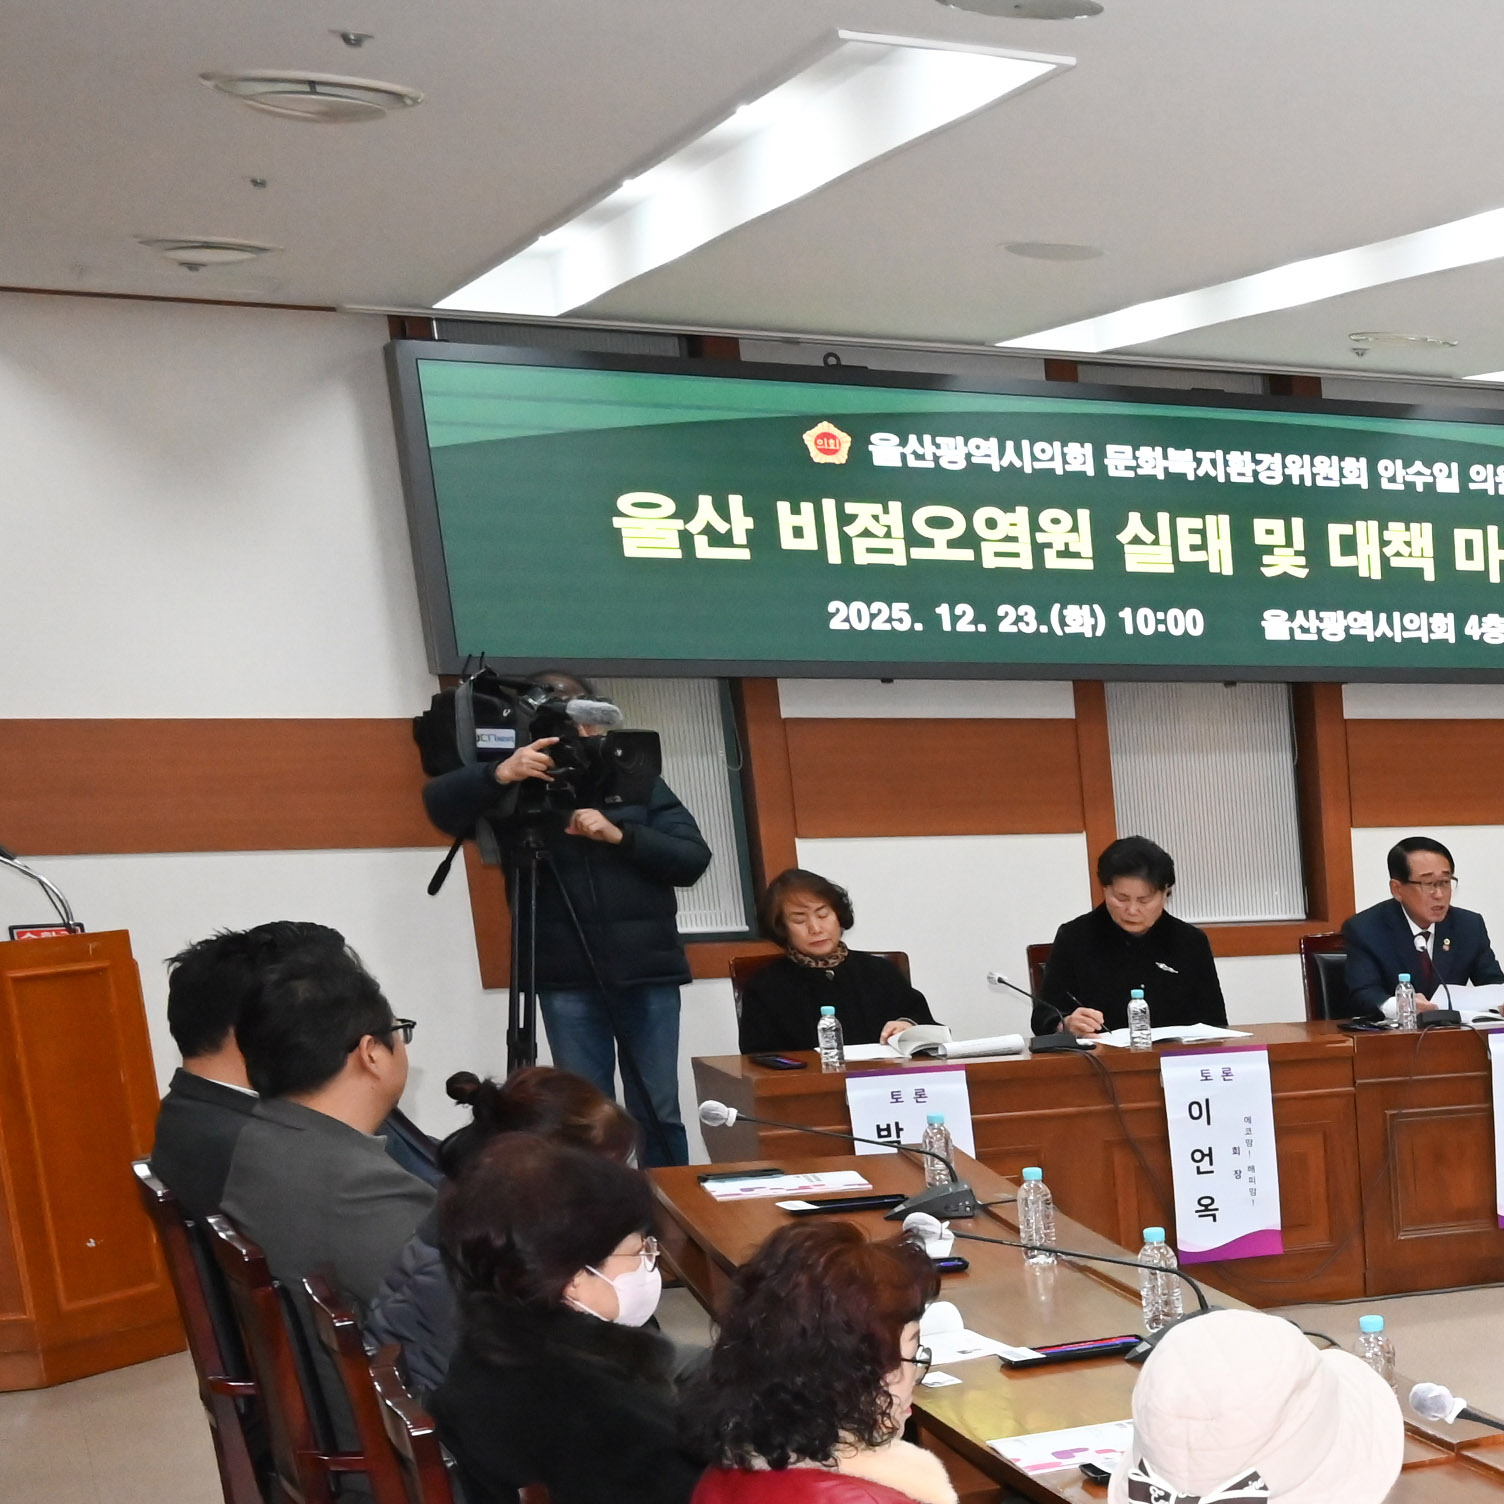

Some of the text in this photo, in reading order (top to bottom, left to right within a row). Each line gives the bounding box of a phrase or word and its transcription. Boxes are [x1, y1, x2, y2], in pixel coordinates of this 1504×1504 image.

[816, 437, 840, 450] 의회
[868, 432, 1095, 477] 울산광역시의회
[1103, 444, 1369, 490] 문화복지환경위원회
[1377, 458, 1460, 494] 안수일
[612, 491, 754, 560] 울산
[776, 498, 1094, 570] 비점오염원
[1115, 511, 1234, 576] 실태
[1253, 517, 1310, 579] 및
[1327, 520, 1436, 582] 대책
[827, 600, 1205, 638] 2025. 12. 23.(화) 10:00
[1260, 609, 1456, 644] 울산광역시의회
[1199, 1066, 1235, 1082] 토론
[889, 1087, 929, 1104] 토론
[1188, 1097, 1220, 1223] 이언옥
[1231, 1146, 1242, 1180] 회장
